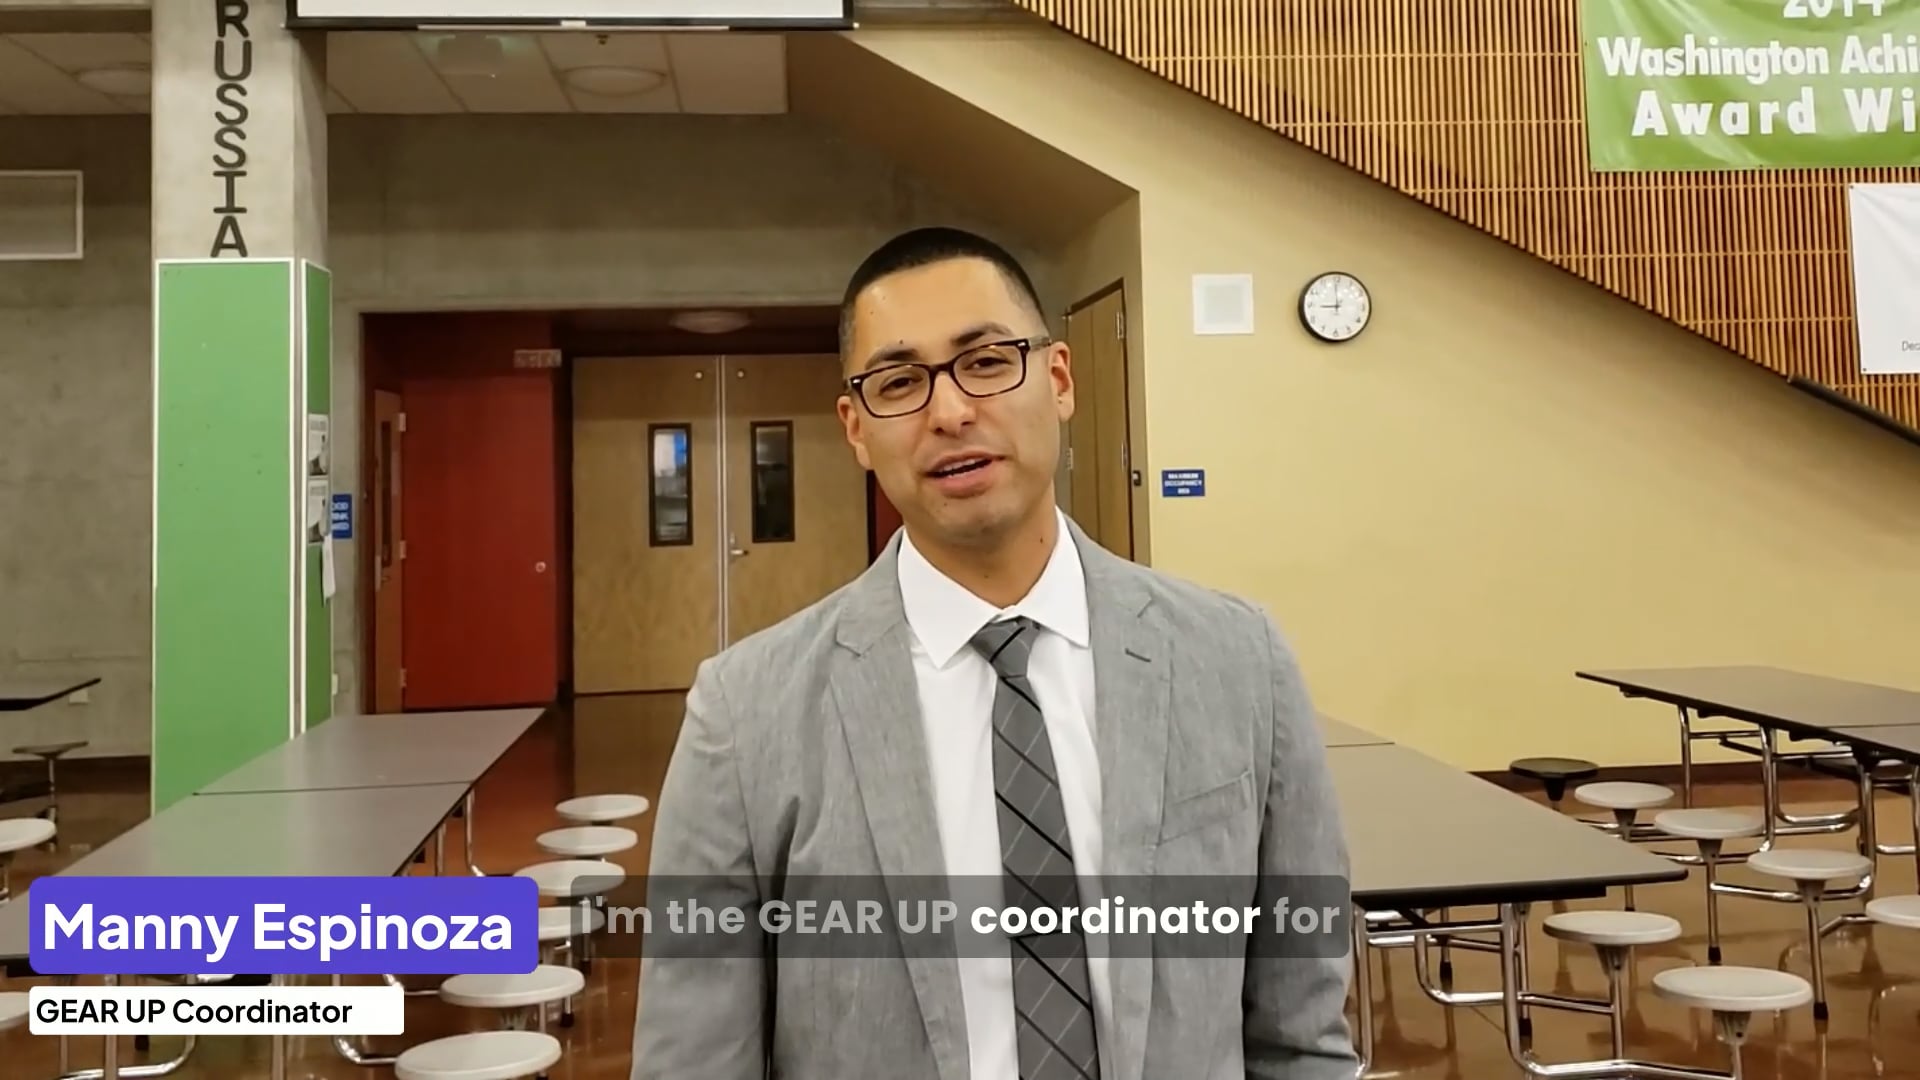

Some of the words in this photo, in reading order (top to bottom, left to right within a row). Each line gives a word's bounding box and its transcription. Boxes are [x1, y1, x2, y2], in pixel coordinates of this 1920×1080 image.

[1598, 34, 1829, 84] Washington
[210, 0, 252, 258] RUSSIA
[1632, 87, 1817, 136] Award
[1843, 87, 1917, 133] Wi
